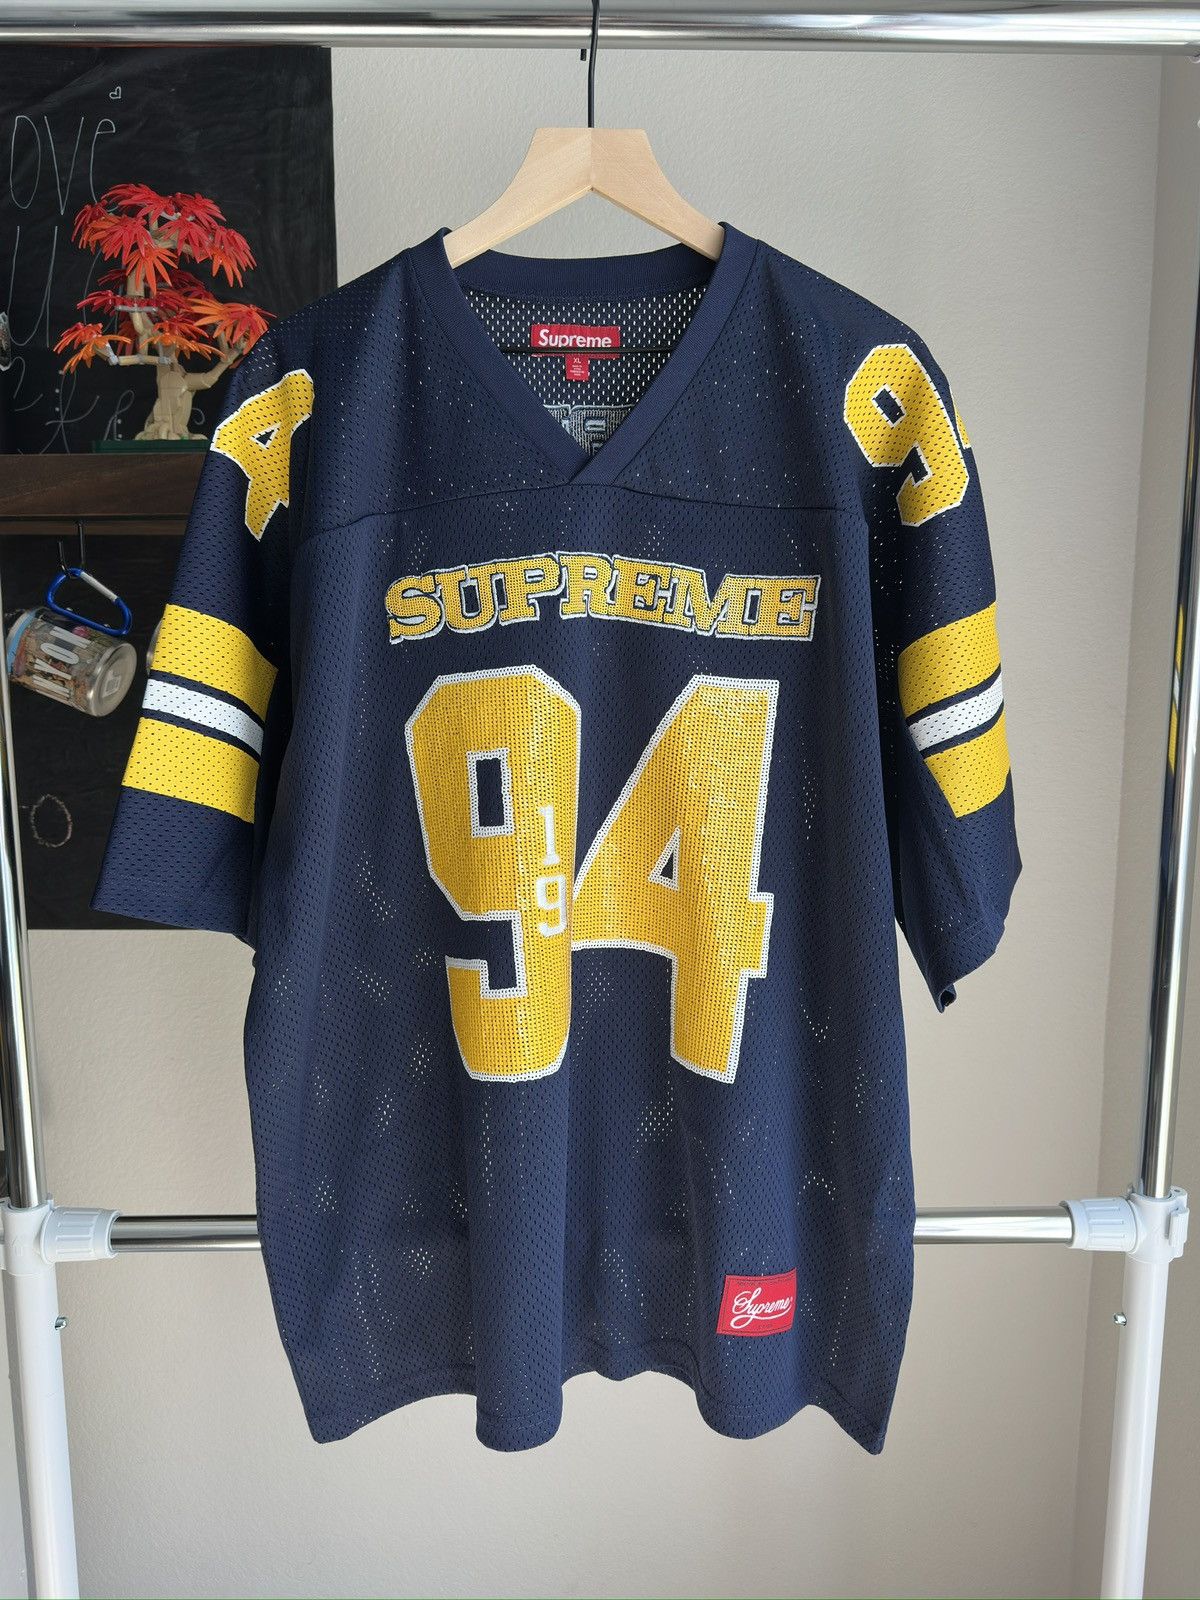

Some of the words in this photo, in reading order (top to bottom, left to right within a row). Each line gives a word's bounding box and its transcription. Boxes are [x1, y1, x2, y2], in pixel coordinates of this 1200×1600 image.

[538, 328, 612, 347] Supreme
[843, 343, 972, 528] 9
[384, 551, 822, 644] SUPREME
[404, 664, 780, 1084] 94
[730, 1287, 794, 1329] Supreme
